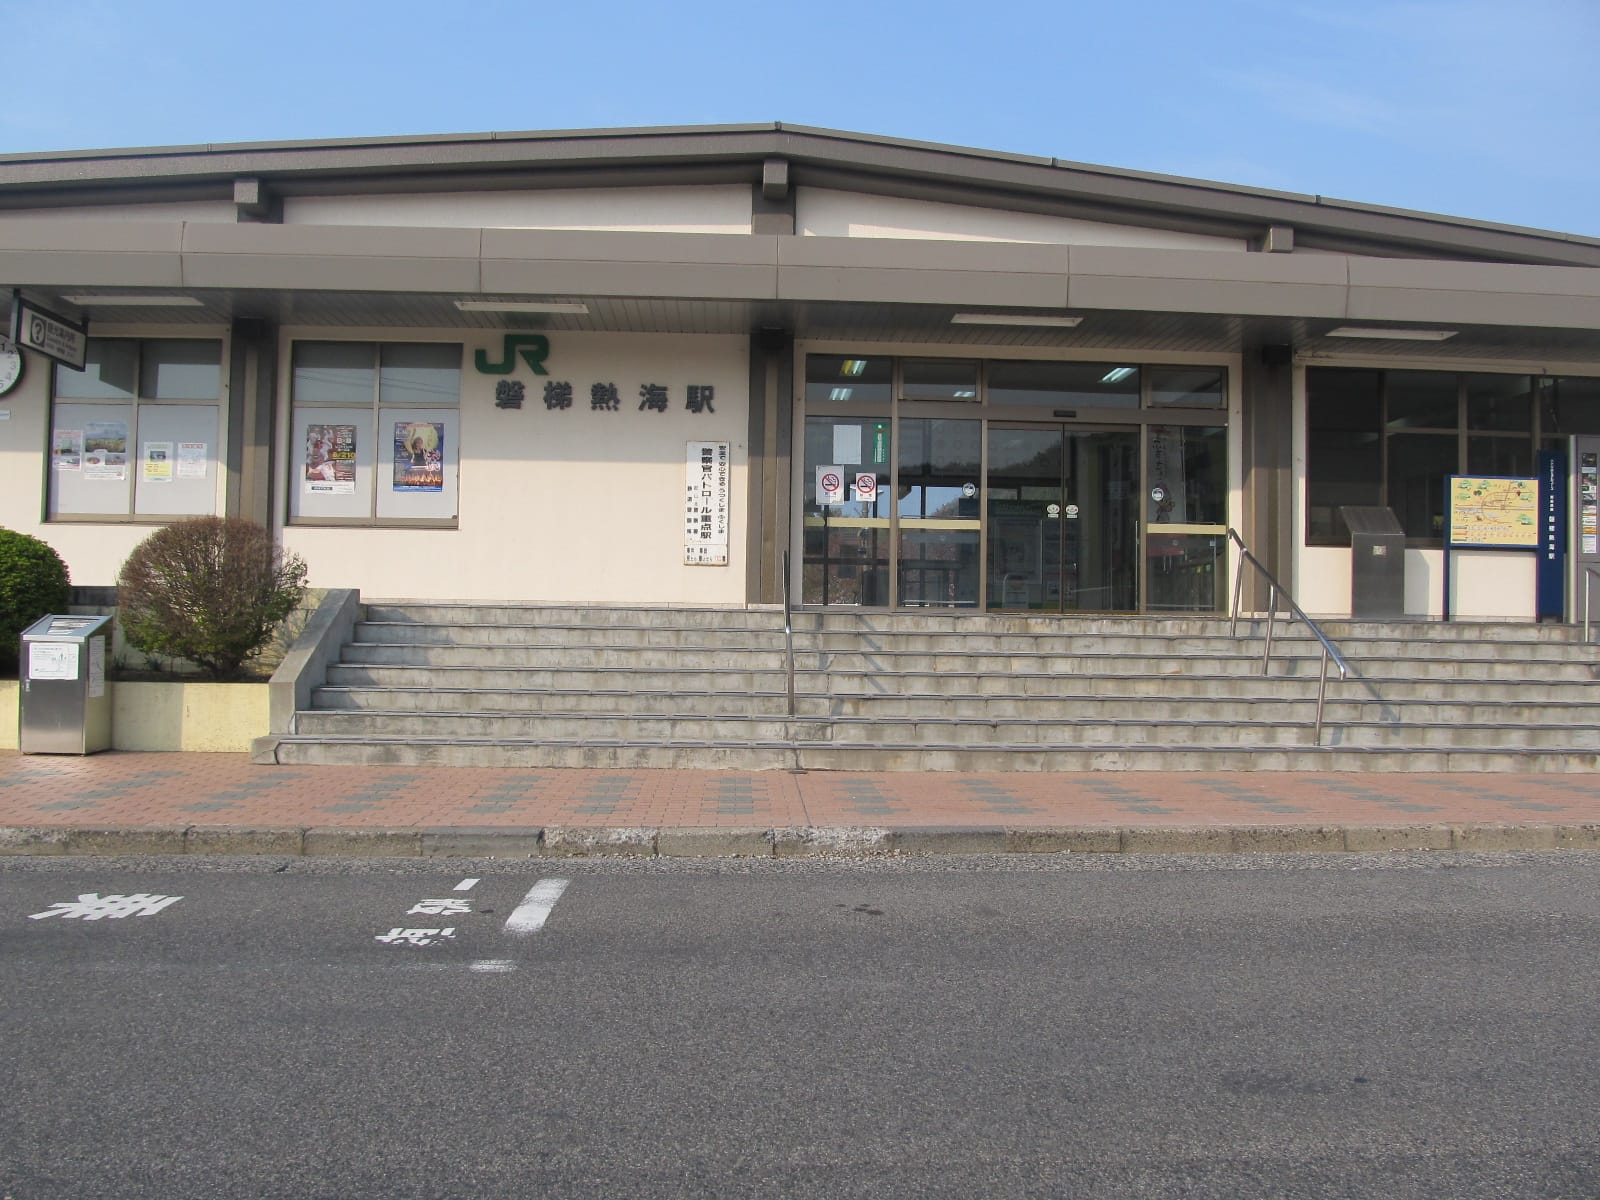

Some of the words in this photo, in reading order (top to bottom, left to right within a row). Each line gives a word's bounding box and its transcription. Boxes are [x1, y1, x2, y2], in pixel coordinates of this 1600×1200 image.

[474, 334, 549, 376] JR
[494, 379, 716, 414] 磐梯熱海駅
[700, 447, 713, 539] 警察官パトロール重点駅
